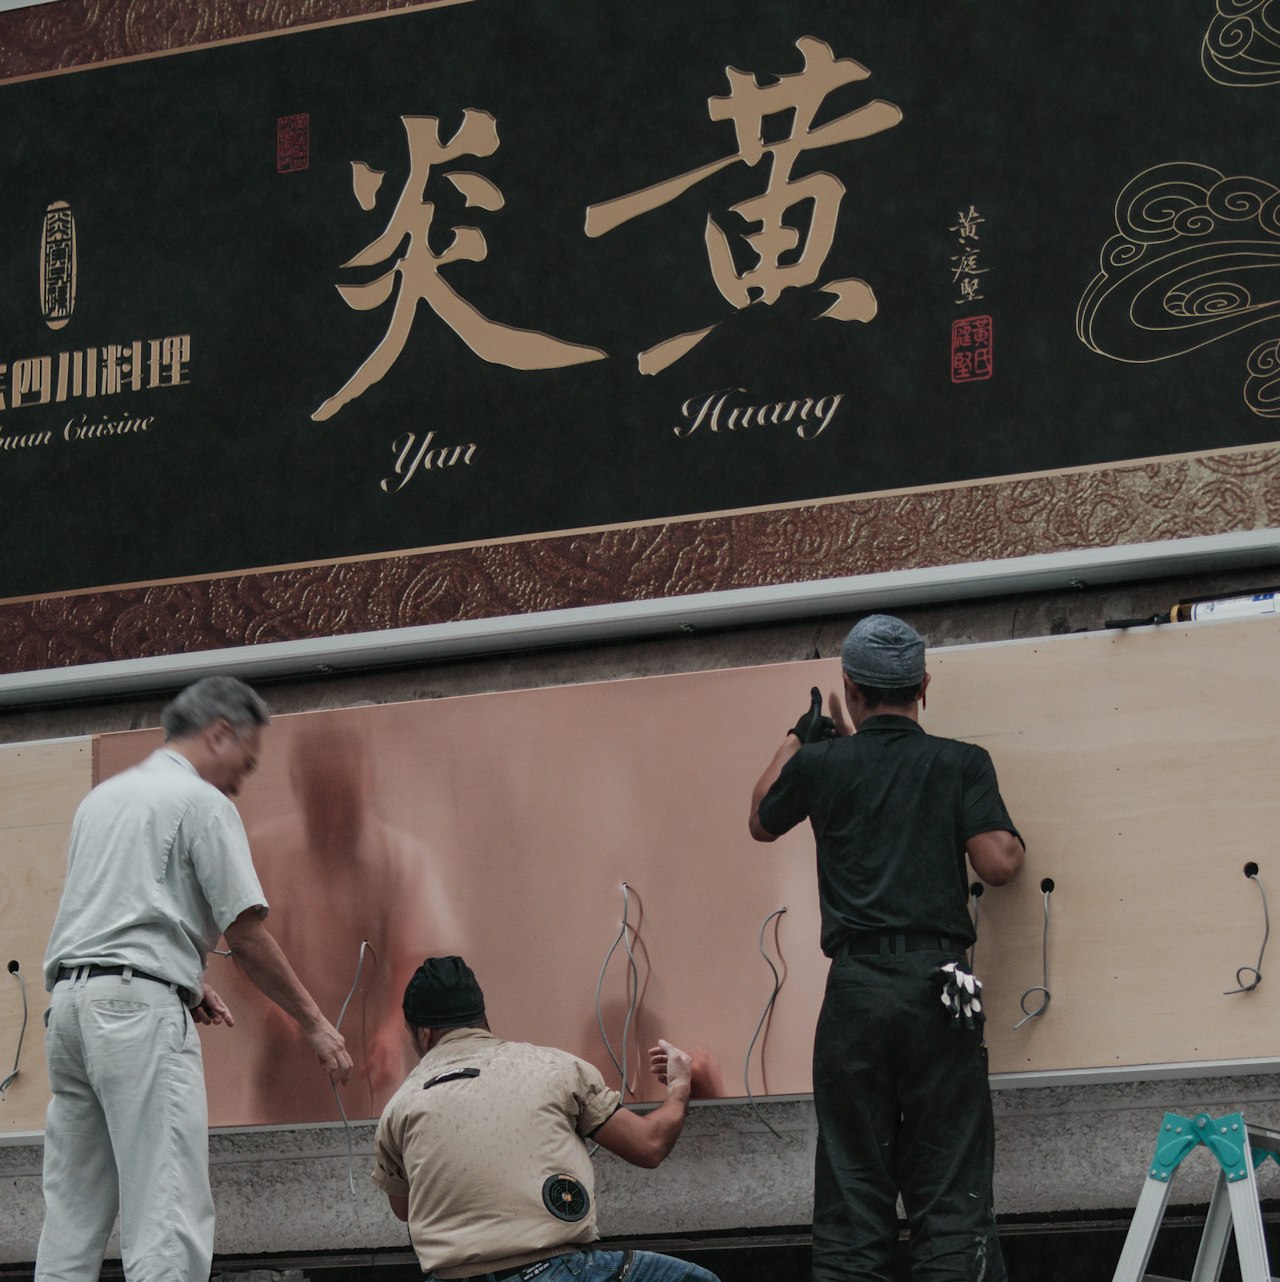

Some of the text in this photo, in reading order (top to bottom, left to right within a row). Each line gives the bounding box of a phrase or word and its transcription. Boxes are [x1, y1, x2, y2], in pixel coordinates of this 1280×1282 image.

[63, 412, 155, 443] Cuisine
[673, 387, 847, 441] Huang
[380, 429, 480, 494] Yan
